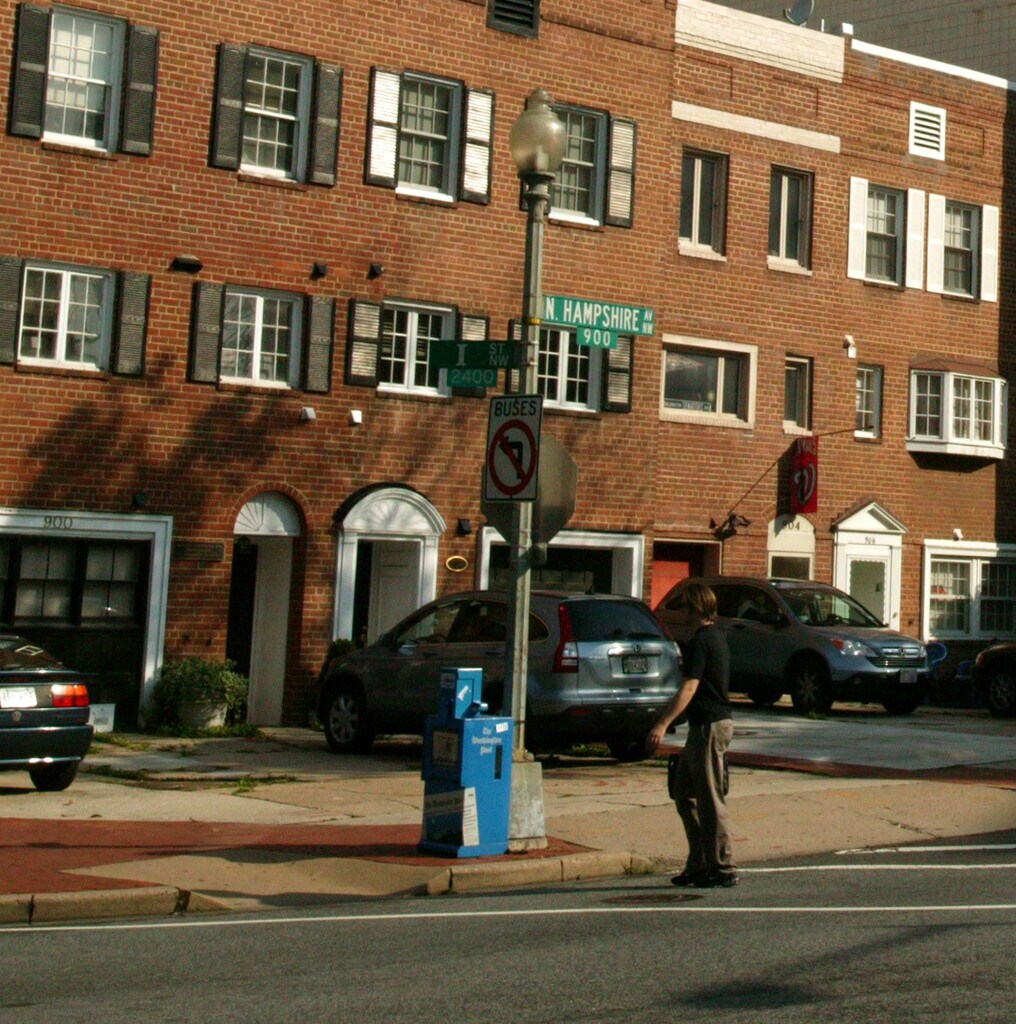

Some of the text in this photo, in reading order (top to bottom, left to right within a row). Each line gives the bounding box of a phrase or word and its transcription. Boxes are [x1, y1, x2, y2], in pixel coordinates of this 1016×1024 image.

[545, 297, 640, 332] N. HAMPSHIRE
[644, 309, 653, 322] AV
[583, 328, 611, 347] 900
[642, 323, 653, 335] NW
[456, 342, 505, 366] I ST
[490, 355, 509, 367] NW
[450, 368, 494, 385] 2400
[494, 400, 537, 417] BUSES
[44, 516, 73, 529] 900
